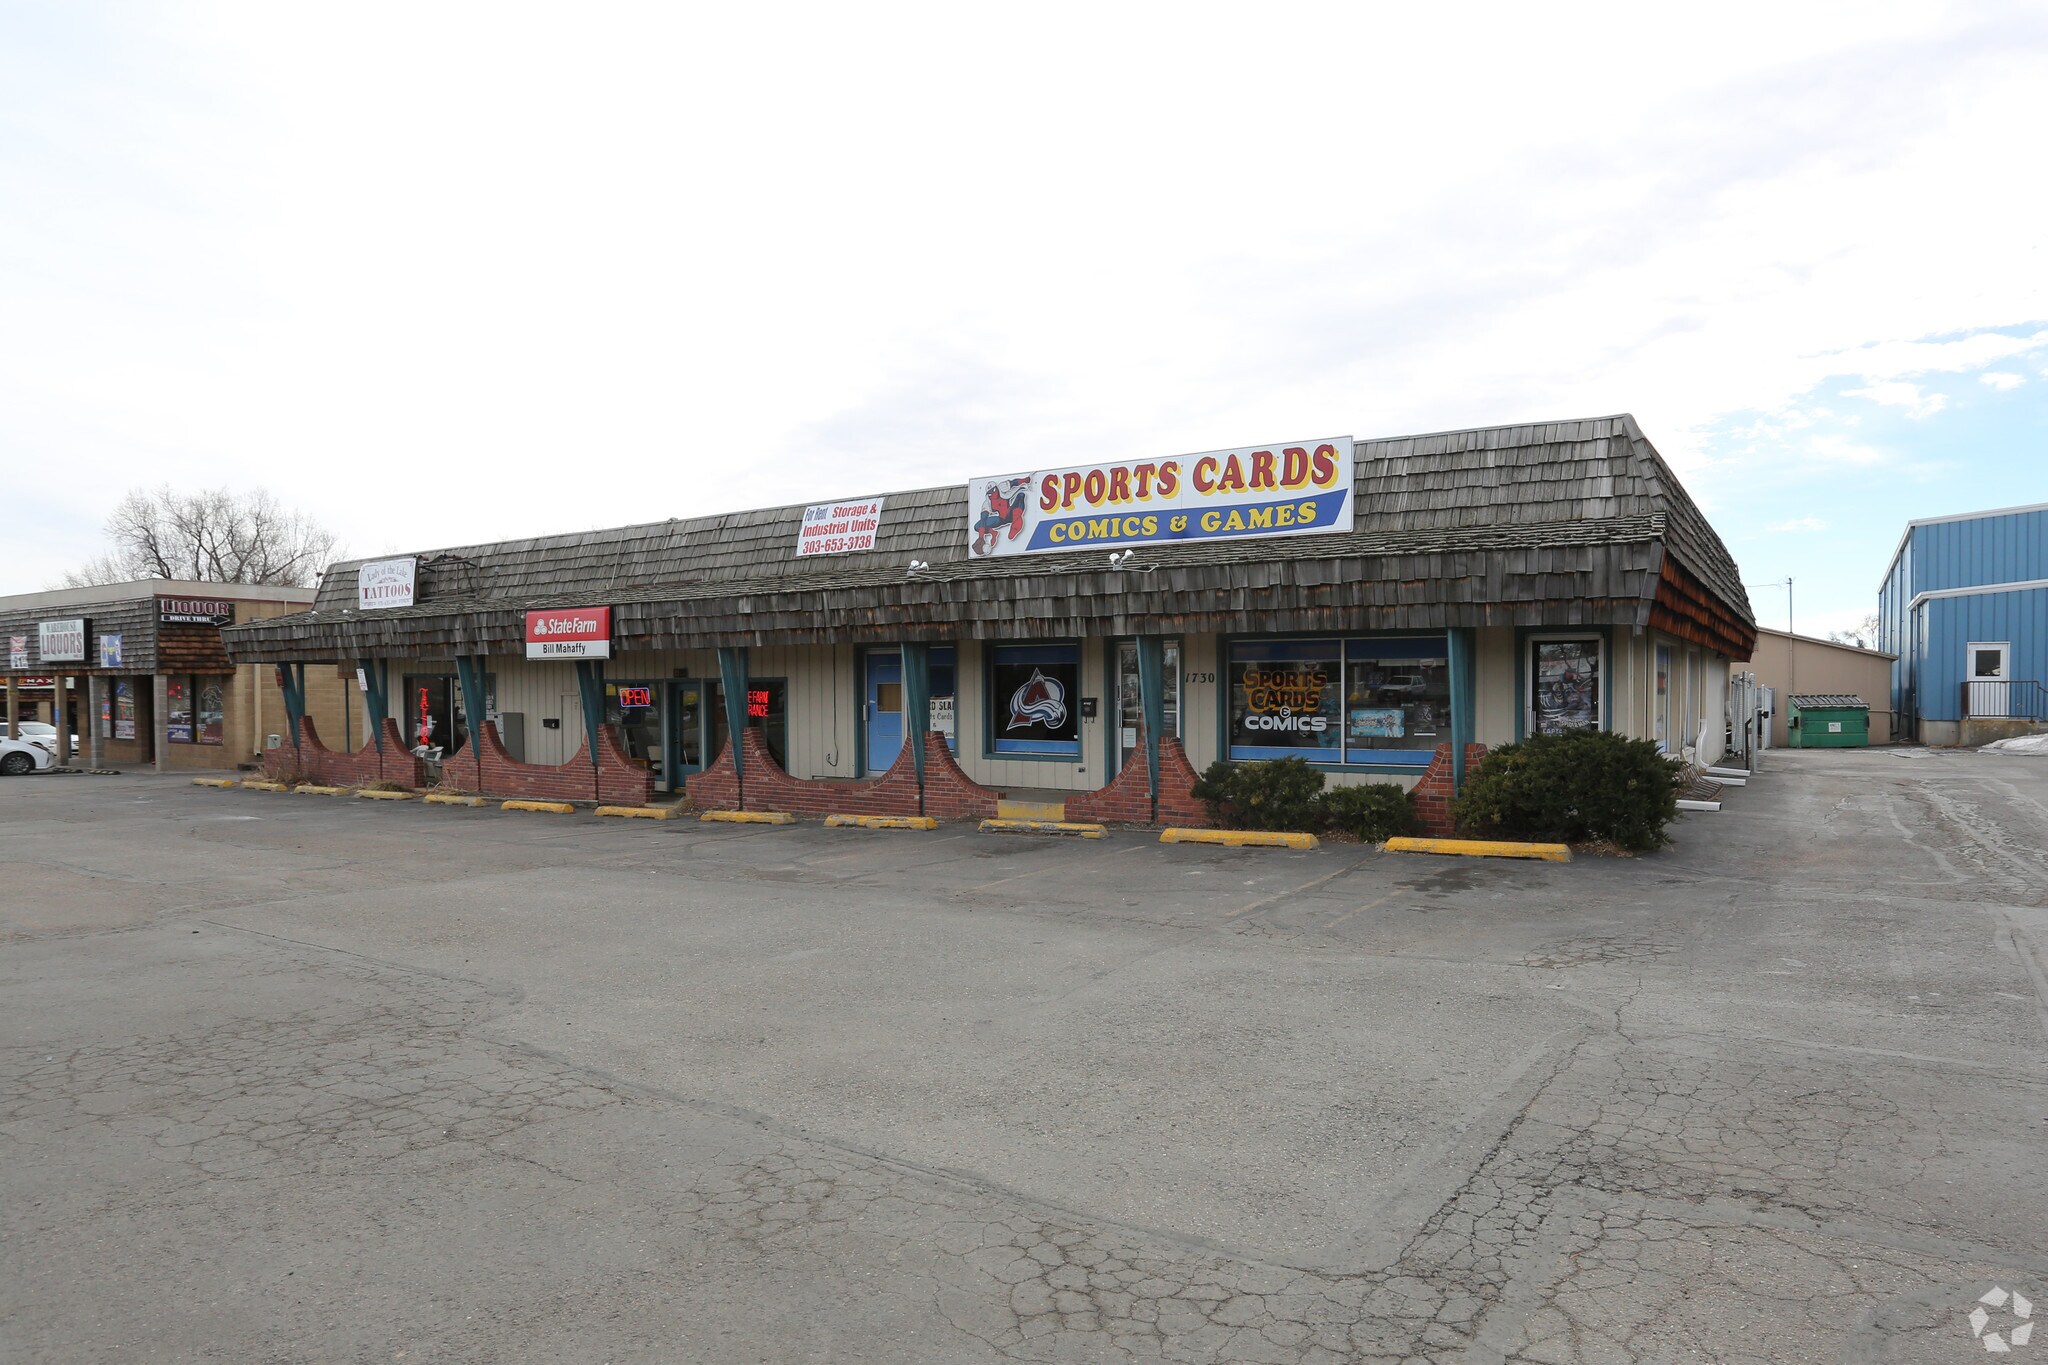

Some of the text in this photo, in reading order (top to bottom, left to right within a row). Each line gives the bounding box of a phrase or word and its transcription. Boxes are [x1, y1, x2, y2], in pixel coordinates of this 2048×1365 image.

[1040, 444, 1339, 514] SPORTS CARDS
[805, 503, 877, 521] For Rent Storage &
[803, 518, 876, 537] Industrial Units
[1049, 501, 1317, 543] COMICS & GAMES
[367, 569, 380, 581] Lady
[381, 566, 387, 576] of
[388, 565, 396, 575] the
[363, 583, 411, 600] TATTOOS
[161, 599, 229, 615] LIQUOR
[42, 632, 83, 655] LIQUORS
[543, 643, 586, 655] Bill Mahaffy
[1185, 673, 1215, 683] 1730
[1243, 670, 1327, 692] SPORTS
[621, 689, 650, 705] OPEN
[1248, 687, 1320, 713] CARDS
[1245, 716, 1327, 731] COMICS
